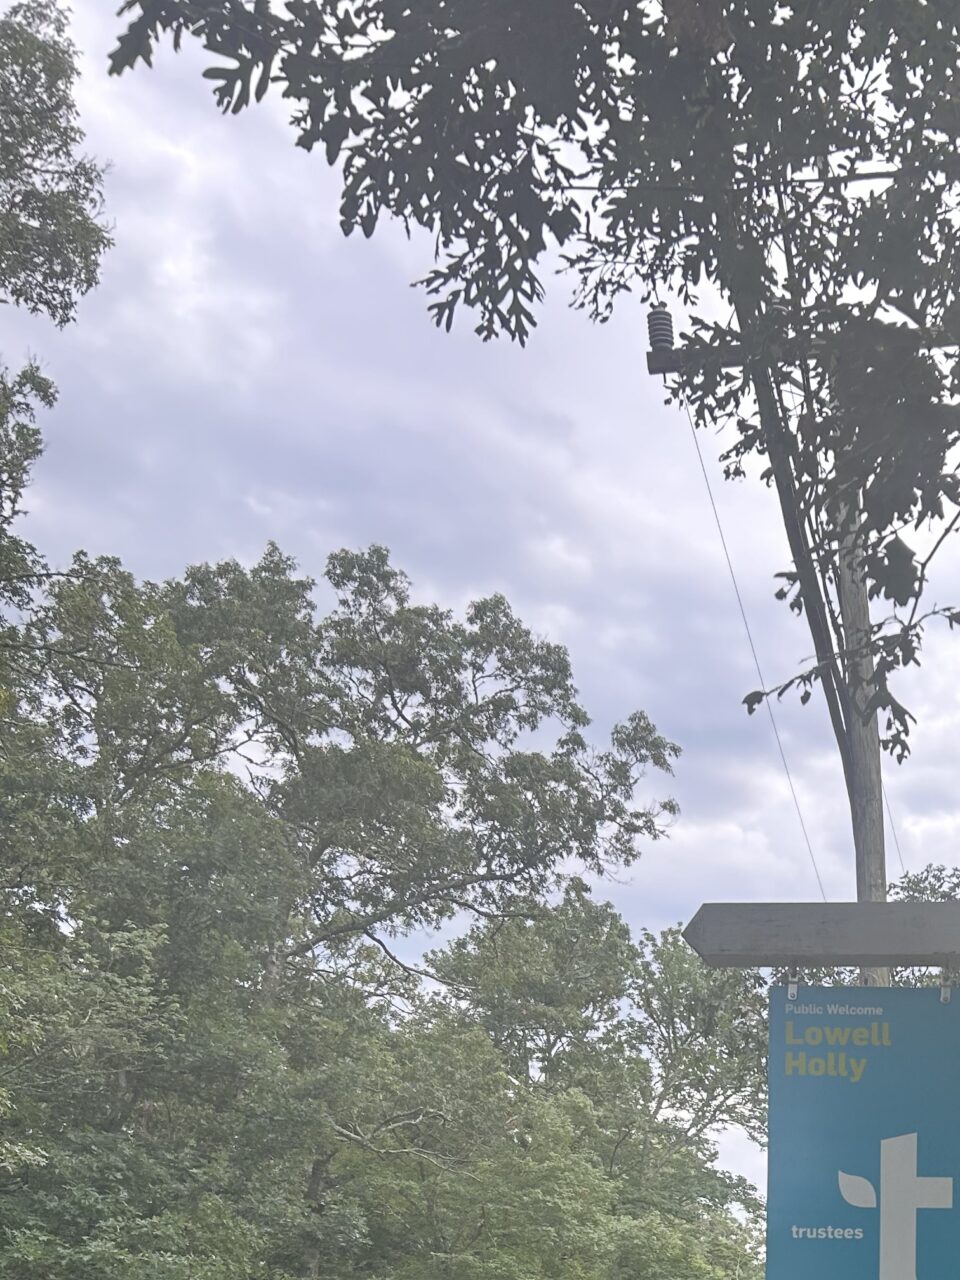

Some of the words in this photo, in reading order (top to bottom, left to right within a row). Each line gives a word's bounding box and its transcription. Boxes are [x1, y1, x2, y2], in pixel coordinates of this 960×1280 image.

[785, 1003, 823, 1015] Public
[827, 1004, 883, 1016] Welcome
[785, 1020, 892, 1047] Lowell
[785, 1050, 867, 1083] Holly
[791, 1224, 864, 1239] trustees
